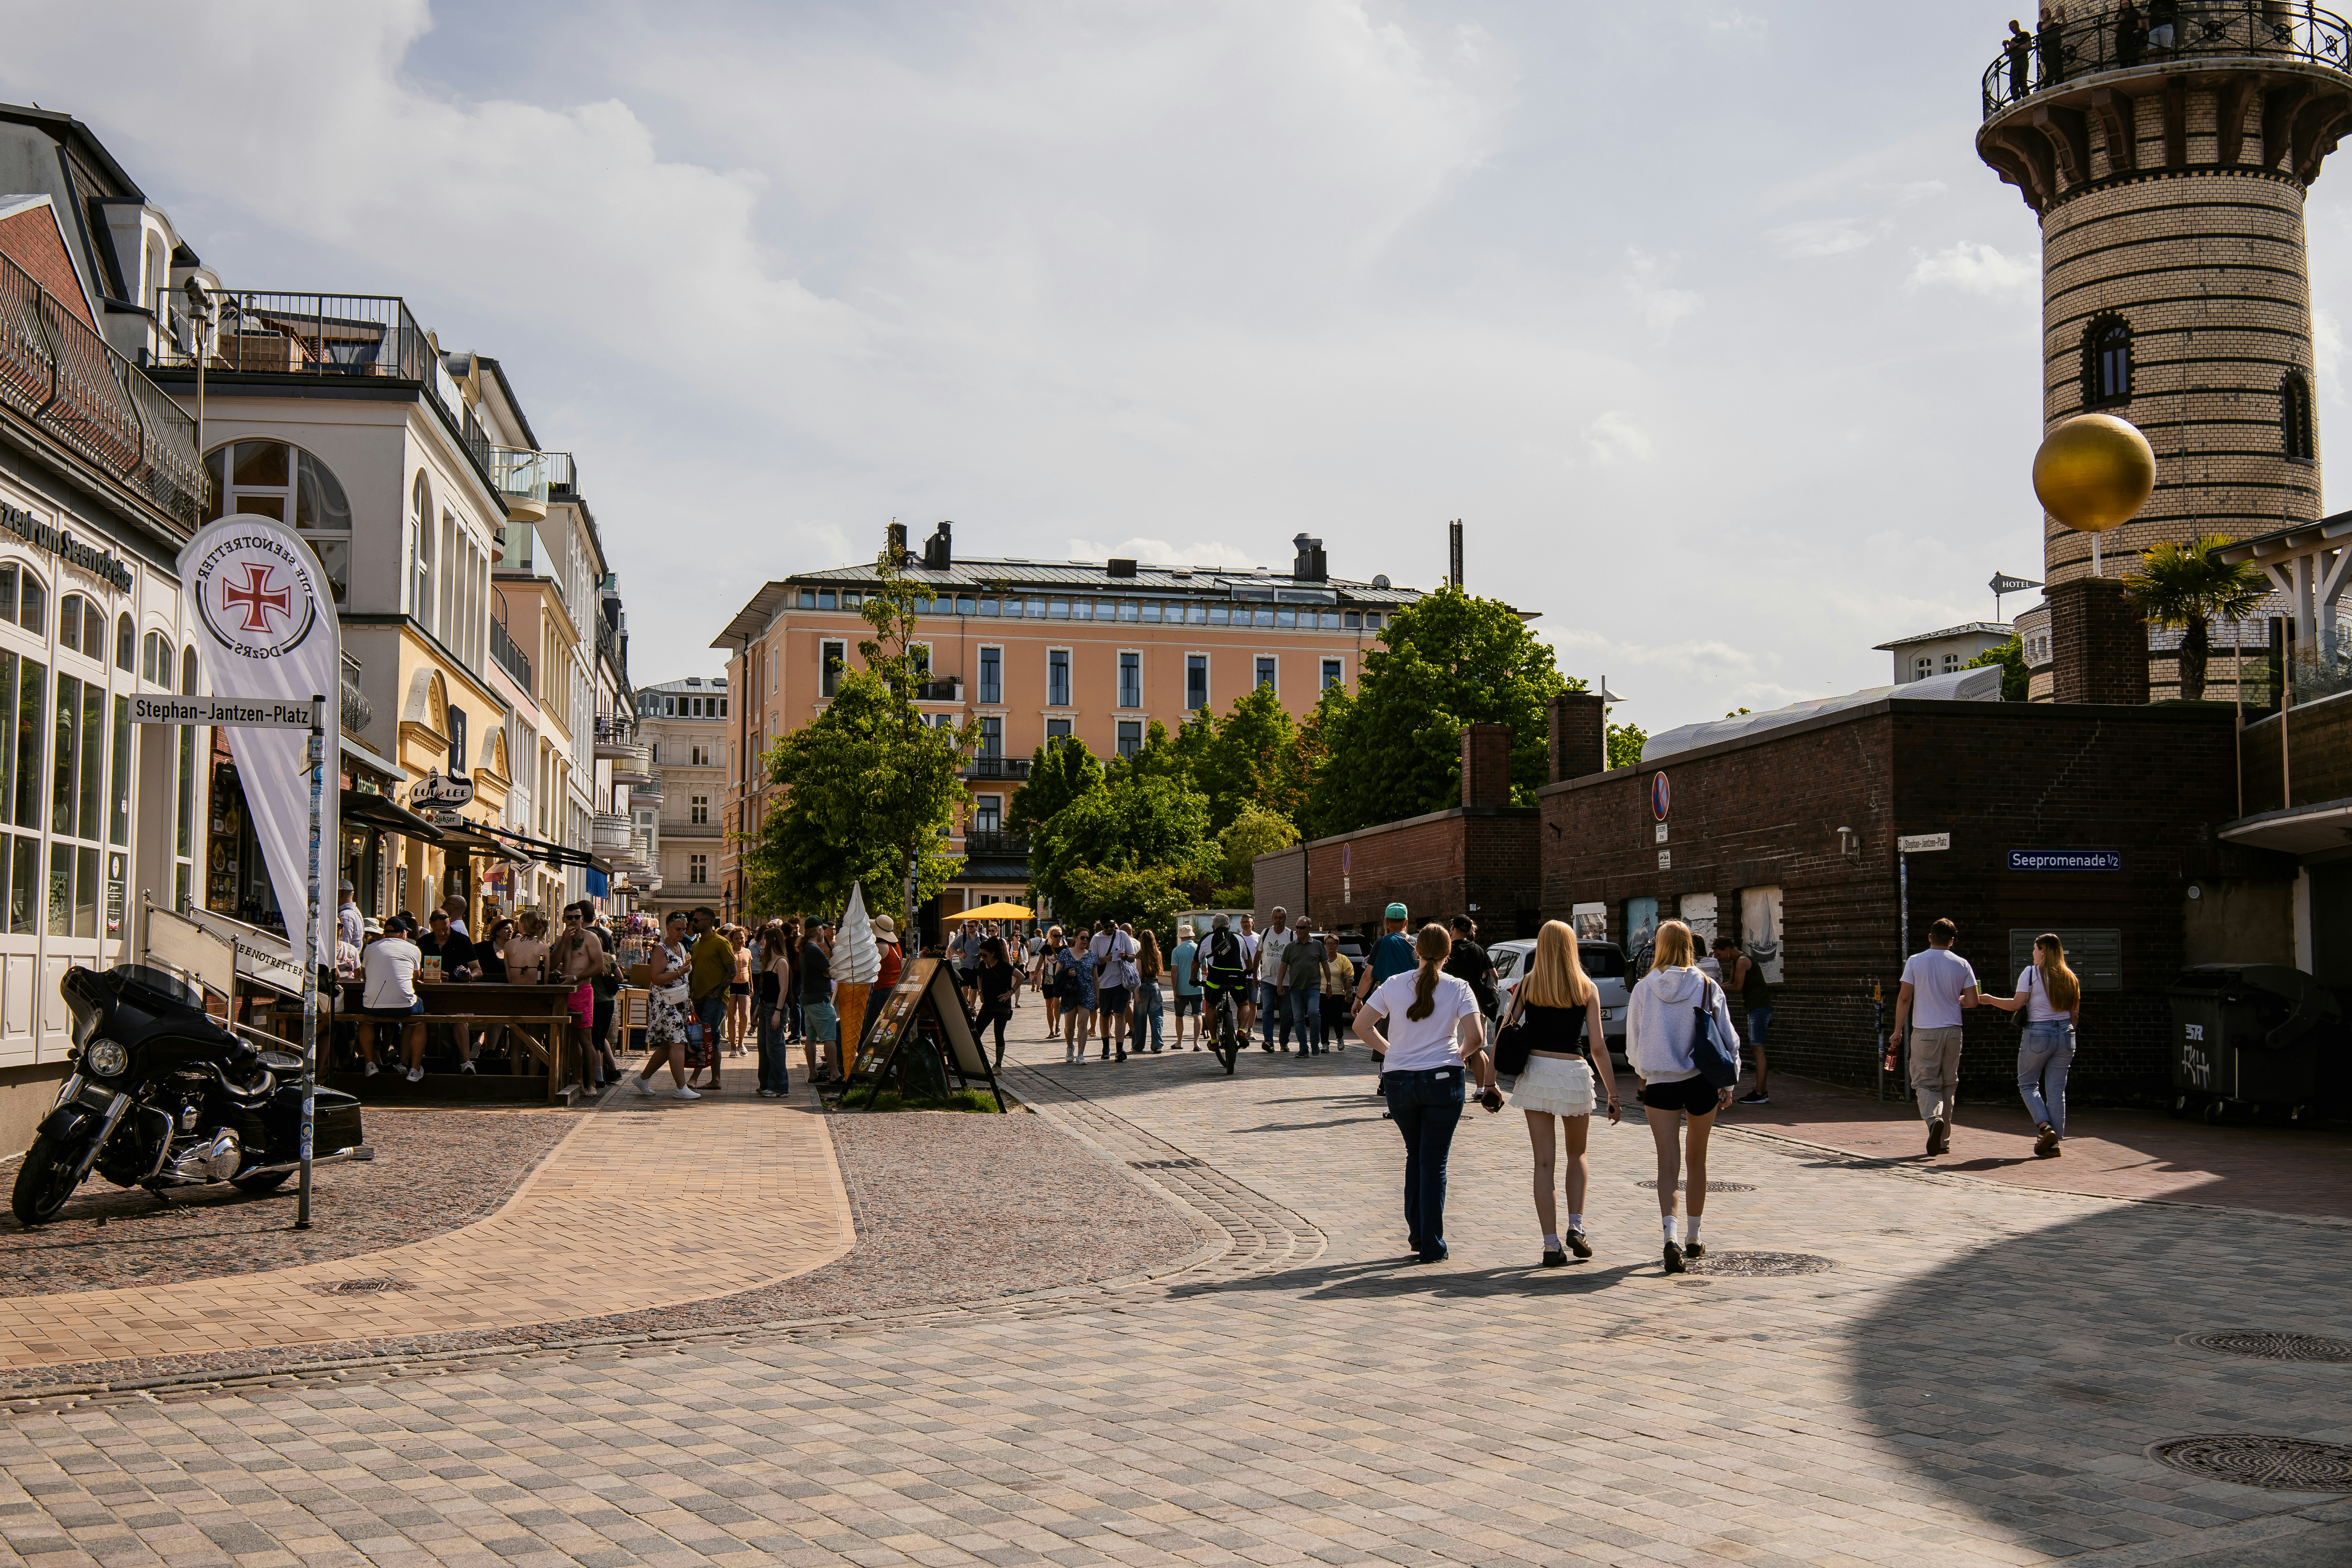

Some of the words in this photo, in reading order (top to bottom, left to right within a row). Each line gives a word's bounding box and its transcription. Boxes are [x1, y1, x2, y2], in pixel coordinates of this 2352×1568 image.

[61, 530, 133, 594] Seenotretter
[135, 699, 309, 724] Stephan-Jantzen-Platz
[446, 788, 468, 797] LEE
[434, 814, 456, 824] Lübzer
[1905, 837, 1947, 851] Stephan-Jantzen-Platz
[2013, 853, 2106, 869] Seepromenade
